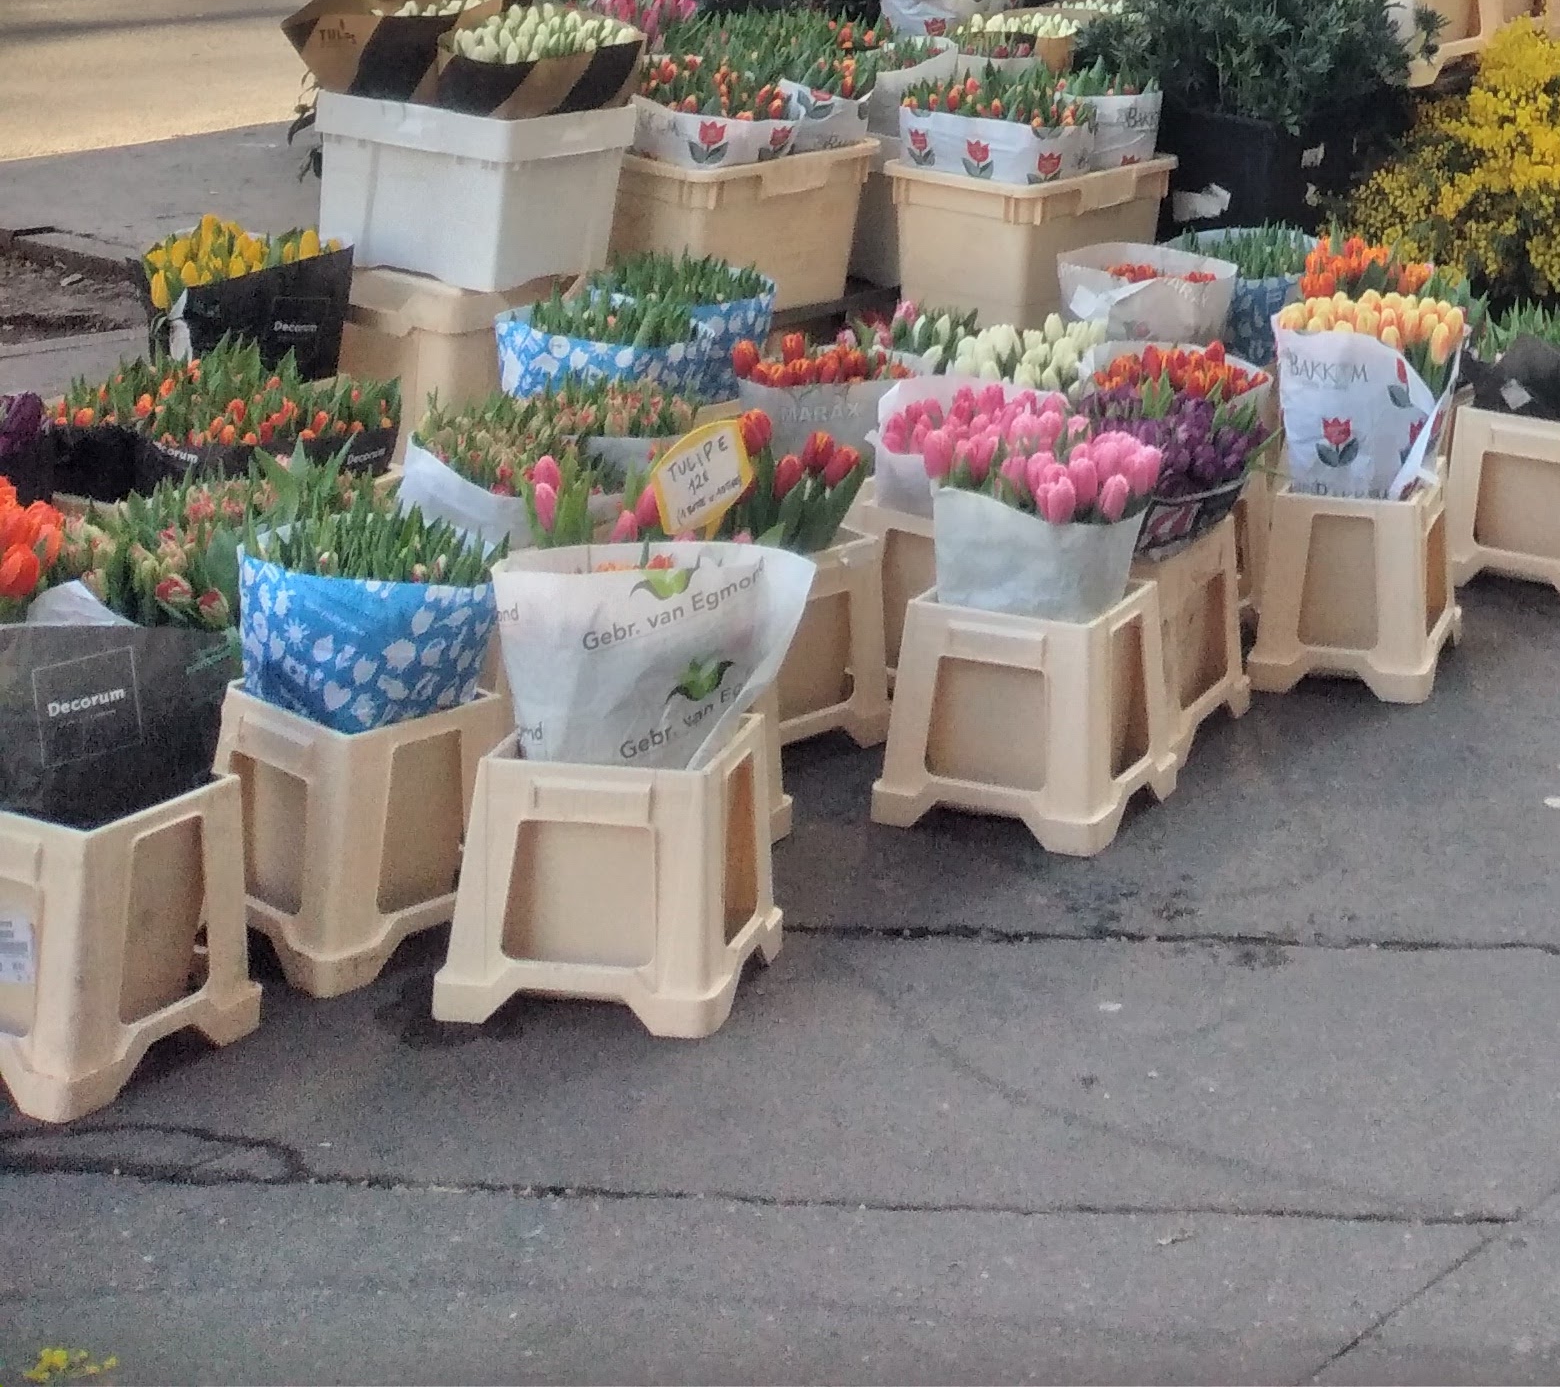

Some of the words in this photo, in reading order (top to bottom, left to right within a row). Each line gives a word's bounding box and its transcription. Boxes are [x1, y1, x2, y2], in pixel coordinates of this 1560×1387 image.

[273, 320, 318, 333] Decorum
[667, 435, 729, 483] TULIPE
[582, 621, 641, 652] Gebr.
[646, 605, 685, 629] van
[48, 688, 126, 717] Decorum
[619, 724, 679, 760] Gebr.
[682, 702, 715, 728] van
